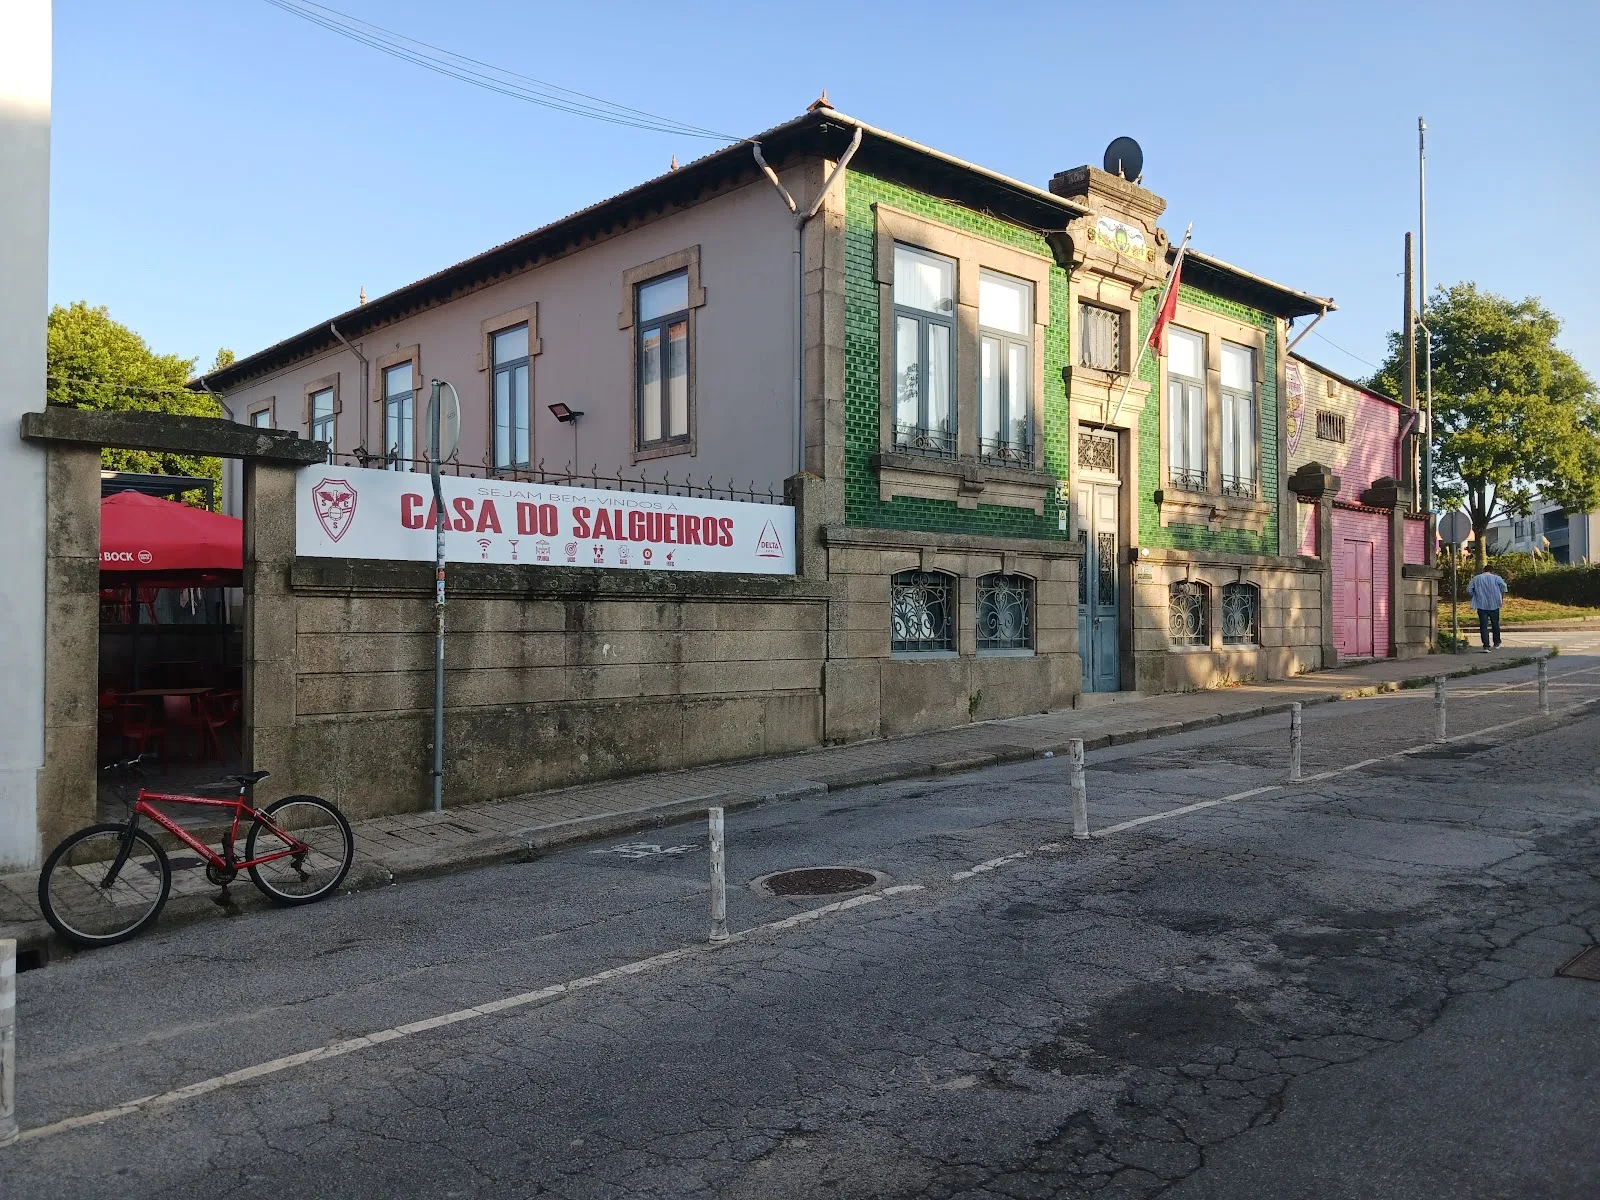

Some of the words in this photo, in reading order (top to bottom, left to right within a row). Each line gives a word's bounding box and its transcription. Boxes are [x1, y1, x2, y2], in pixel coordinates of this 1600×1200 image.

[477, 487, 543, 501] SEJAM
[549, 493, 663, 510] BEM-VINDOS
[400, 493, 503, 534] CASA
[516, 502, 559, 537] DO
[572, 506, 734, 547] SALGUEIROS
[761, 541, 779, 549] DELTA
[103, 551, 135, 561] BOCK
